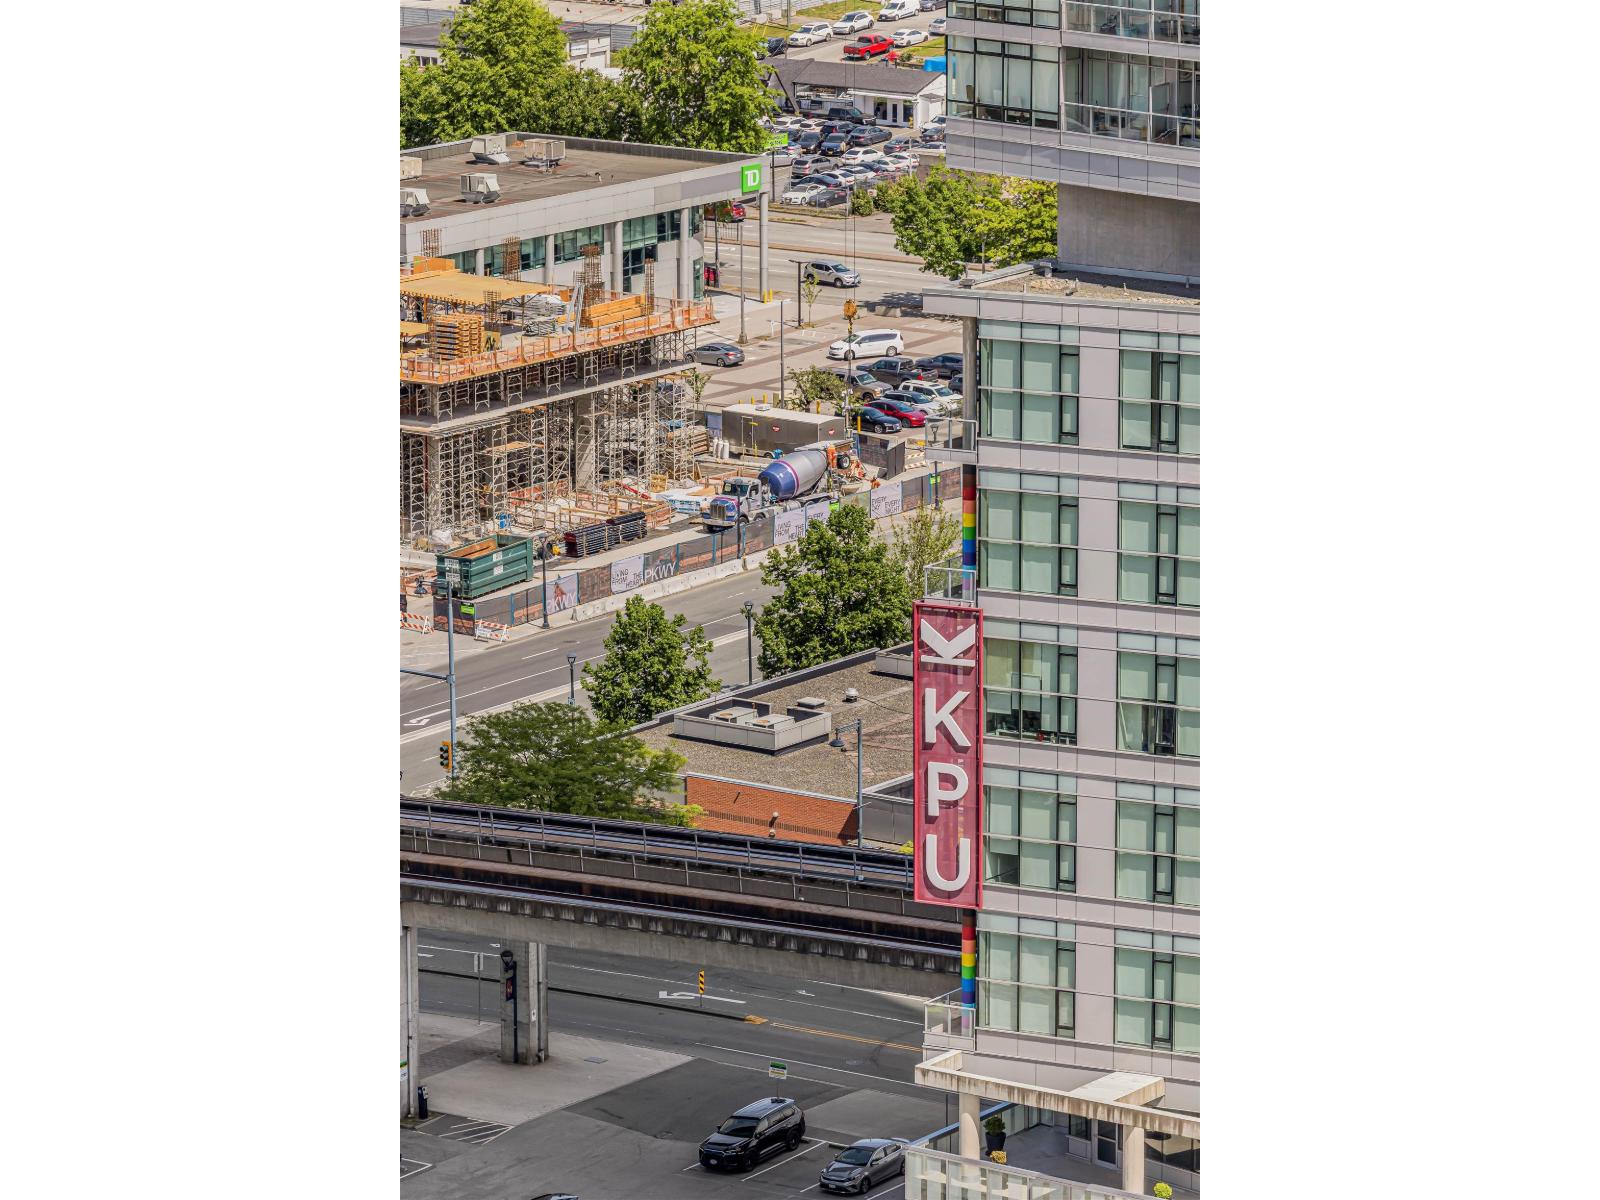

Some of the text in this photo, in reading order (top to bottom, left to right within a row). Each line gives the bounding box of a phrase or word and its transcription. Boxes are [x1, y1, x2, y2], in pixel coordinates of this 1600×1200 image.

[745, 169, 760, 186] TD
[633, 571, 643, 580] THE
[644, 560, 677, 583] PKWY
[922, 687, 972, 892] KPU
